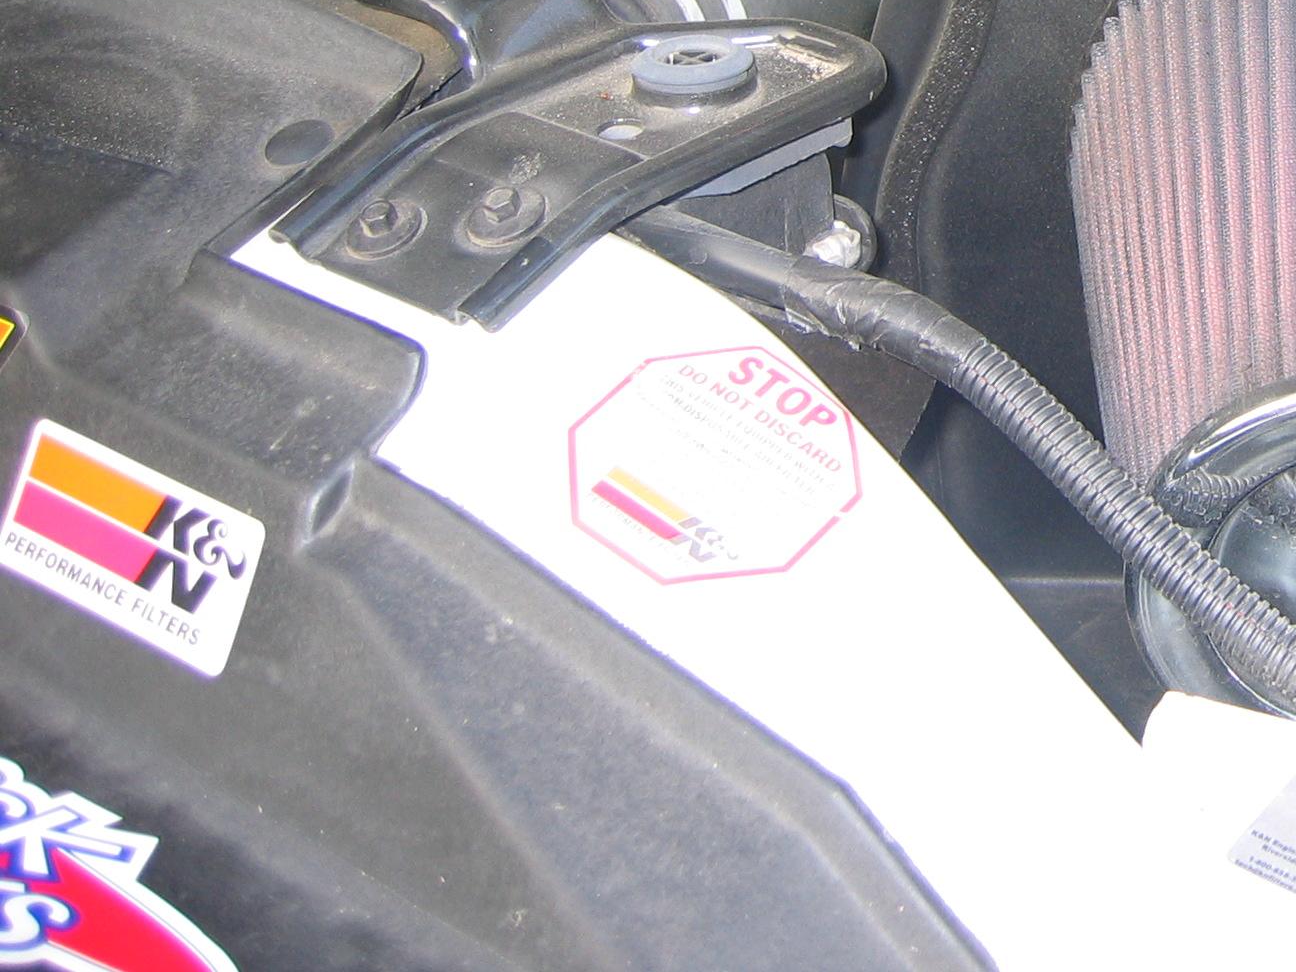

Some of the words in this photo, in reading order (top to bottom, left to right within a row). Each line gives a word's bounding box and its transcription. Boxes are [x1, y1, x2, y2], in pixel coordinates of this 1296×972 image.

[678, 364, 708, 385] DO
[710, 381, 754, 413] NOT
[754, 409, 842, 473] DISCARD
[728, 356, 838, 427] STOP
[4, 531, 129, 606] PERFORMANCE
[131, 598, 201, 646] FILTERS
[133, 494, 247, 615] K&N
